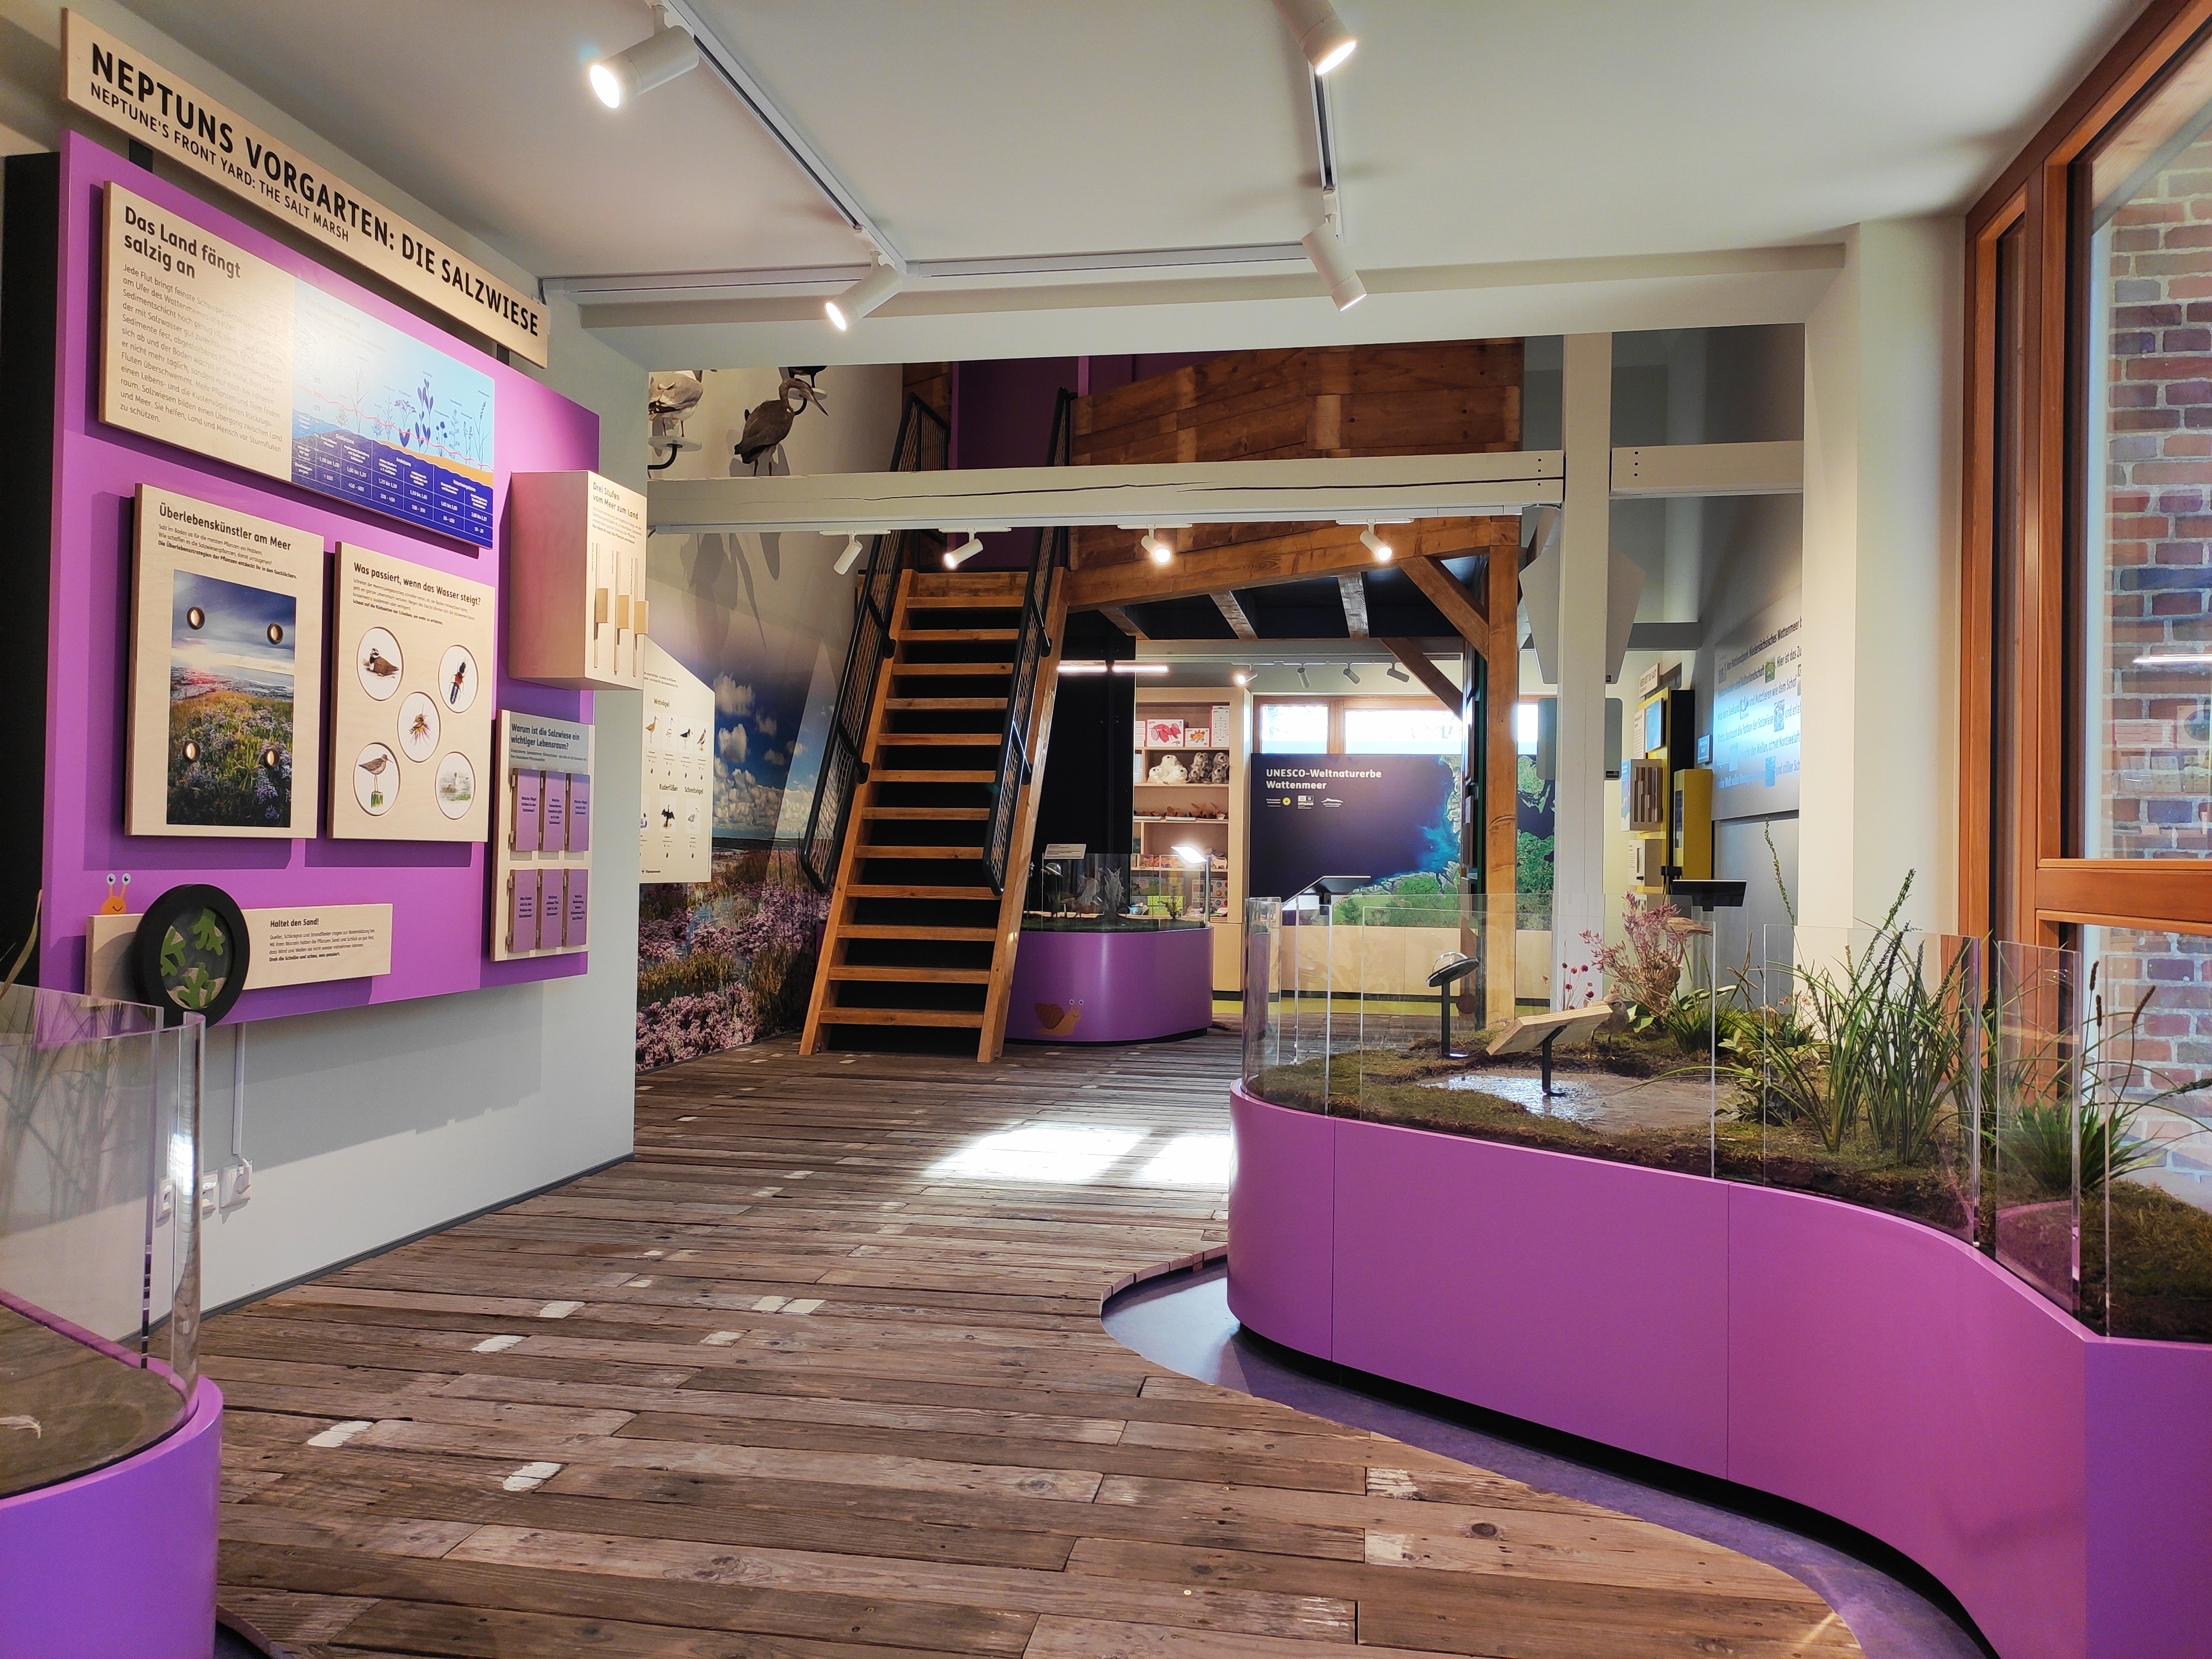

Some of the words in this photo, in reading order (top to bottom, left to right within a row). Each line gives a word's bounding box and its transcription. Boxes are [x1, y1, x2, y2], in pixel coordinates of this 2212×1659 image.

[91, 81, 169, 138] NEPTUNE'S
[174, 130, 216, 165] FRONT
[220, 156, 255, 189] YARD:
[259, 179, 280, 203] THE
[284, 195, 310, 219] SALT
[313, 211, 348, 242] MARSH
[92, 42, 233, 153] NEPTUNS
[245, 136, 394, 251] VORGARTEN:
[402, 233, 435, 275] DIE
[441, 258, 538, 337] SALZWIESE
[124, 234, 171, 272] salzig
[176, 260, 195, 279] an
[125, 205, 155, 236] Das
[160, 223, 197, 257] Land
[201, 244, 241, 279] fängt
[123, 264, 139, 276] Jede
[140, 271, 153, 283] Flut
[154, 276, 173, 293] bringt
[175, 286, 195, 302] feinste
[123, 278, 134, 287] am
[135, 281, 149, 294] Ufer
[151, 289, 163, 300] des
[164, 294, 208, 320] Wattenmeeres
[122, 302, 133, 312] der
[135, 308, 146, 318] mit
[148, 312, 182, 332] Salzwasser
[184, 329, 194, 338] gut
[123, 288, 176, 319] Sedimentschicht
[178, 312, 192, 325] hoch
[194, 321, 213, 336] genug
[122, 314, 157, 335] Sedimente
[159, 328, 172, 342] fest,
[174, 336, 218, 359] abgestorbenes
[122, 327, 135, 338] sich
[137, 333, 145, 342] ab
[147, 338, 159, 348] und
[160, 343, 171, 352] der
[173, 347, 192, 361] Boden
[193, 357, 215, 371] wächst
[215, 364, 221, 373] in
[222, 368, 231, 377] die
[249, 378, 262, 389] Bald
[121, 351, 142, 366] Fluten
[143, 360, 194, 386] überschwemmt.
[195, 380, 210, 392] Mehr
[211, 386, 236, 402] Pflanzen
[237, 398, 248, 407] und
[249, 400, 263, 412] Tiere
[263, 406, 280, 419] finden
[130, 343, 147, 356] nicht
[148, 351, 165, 362] mehr
[166, 357, 189, 373] täglich,
[191, 368, 215, 382] sondern
[216, 378, 226, 386] nur
[227, 382, 241, 393] noch
[242, 386, 251, 396] bei
[119, 403, 128, 411] zu
[129, 406, 160, 422] schützen.
[121, 365, 139, 378] einen
[141, 371, 163, 387] Lebens-
[168, 383, 180, 393] und
[181, 387, 191, 397] die
[192, 391, 227, 410] Küstenvögel
[228, 405, 244, 417] einen
[245, 411, 273, 427] Rückzugs-
[121, 378, 140, 390] raum.
[142, 384, 176, 403] Salzwiesen
[178, 397, 196, 410] bilden
[197, 406, 214, 417] einen
[215, 411, 243, 429] Übergang
[243, 423, 268, 437] zwischen
[269, 431, 282, 442] Land
[120, 391, 133, 400] und
[135, 394, 153, 408] Meer.
[154, 401, 164, 411] Sie
[165, 405, 186, 421] helfen,
[187, 414, 202, 425] Land
[204, 420, 215, 430] und
[216, 424, 238, 437] Mensch
[249, 435, 281, 452] Sturmfluten
[592, 494, 603, 504] vom
[604, 498, 616, 509] Meer
[617, 505, 627, 514] zum
[627, 508, 638, 520] Land
[593, 482, 603, 493] Drei
[604, 487, 619, 501] Stufen
[159, 502, 252, 540] Überlebenskünstler
[254, 534, 267, 544] am
[270, 536, 291, 550] Meer
[174, 528, 186, 536] Boden
[353, 562, 369, 575] Was
[371, 569, 401, 586] passiert,
[403, 578, 421, 589] wenn
[422, 582, 434, 593] das
[436, 585, 459, 599] Wasser
[460, 594, 481, 607] steigt?
[1777, 623, 1799, 641] Wattenmeer
[510, 734, 535, 747] wichtiger
[536, 738, 569, 750] Lebensraum?
[511, 722, 530, 733] Warum
[539, 727, 547, 736] die
[547, 728, 571, 740] Salzwiese
[1266, 769, 1382, 778] UNESCO-Weltnaturerbe
[1266, 780, 1327, 790] Wattenmeer
[302, 917, 319, 926] Sand!
